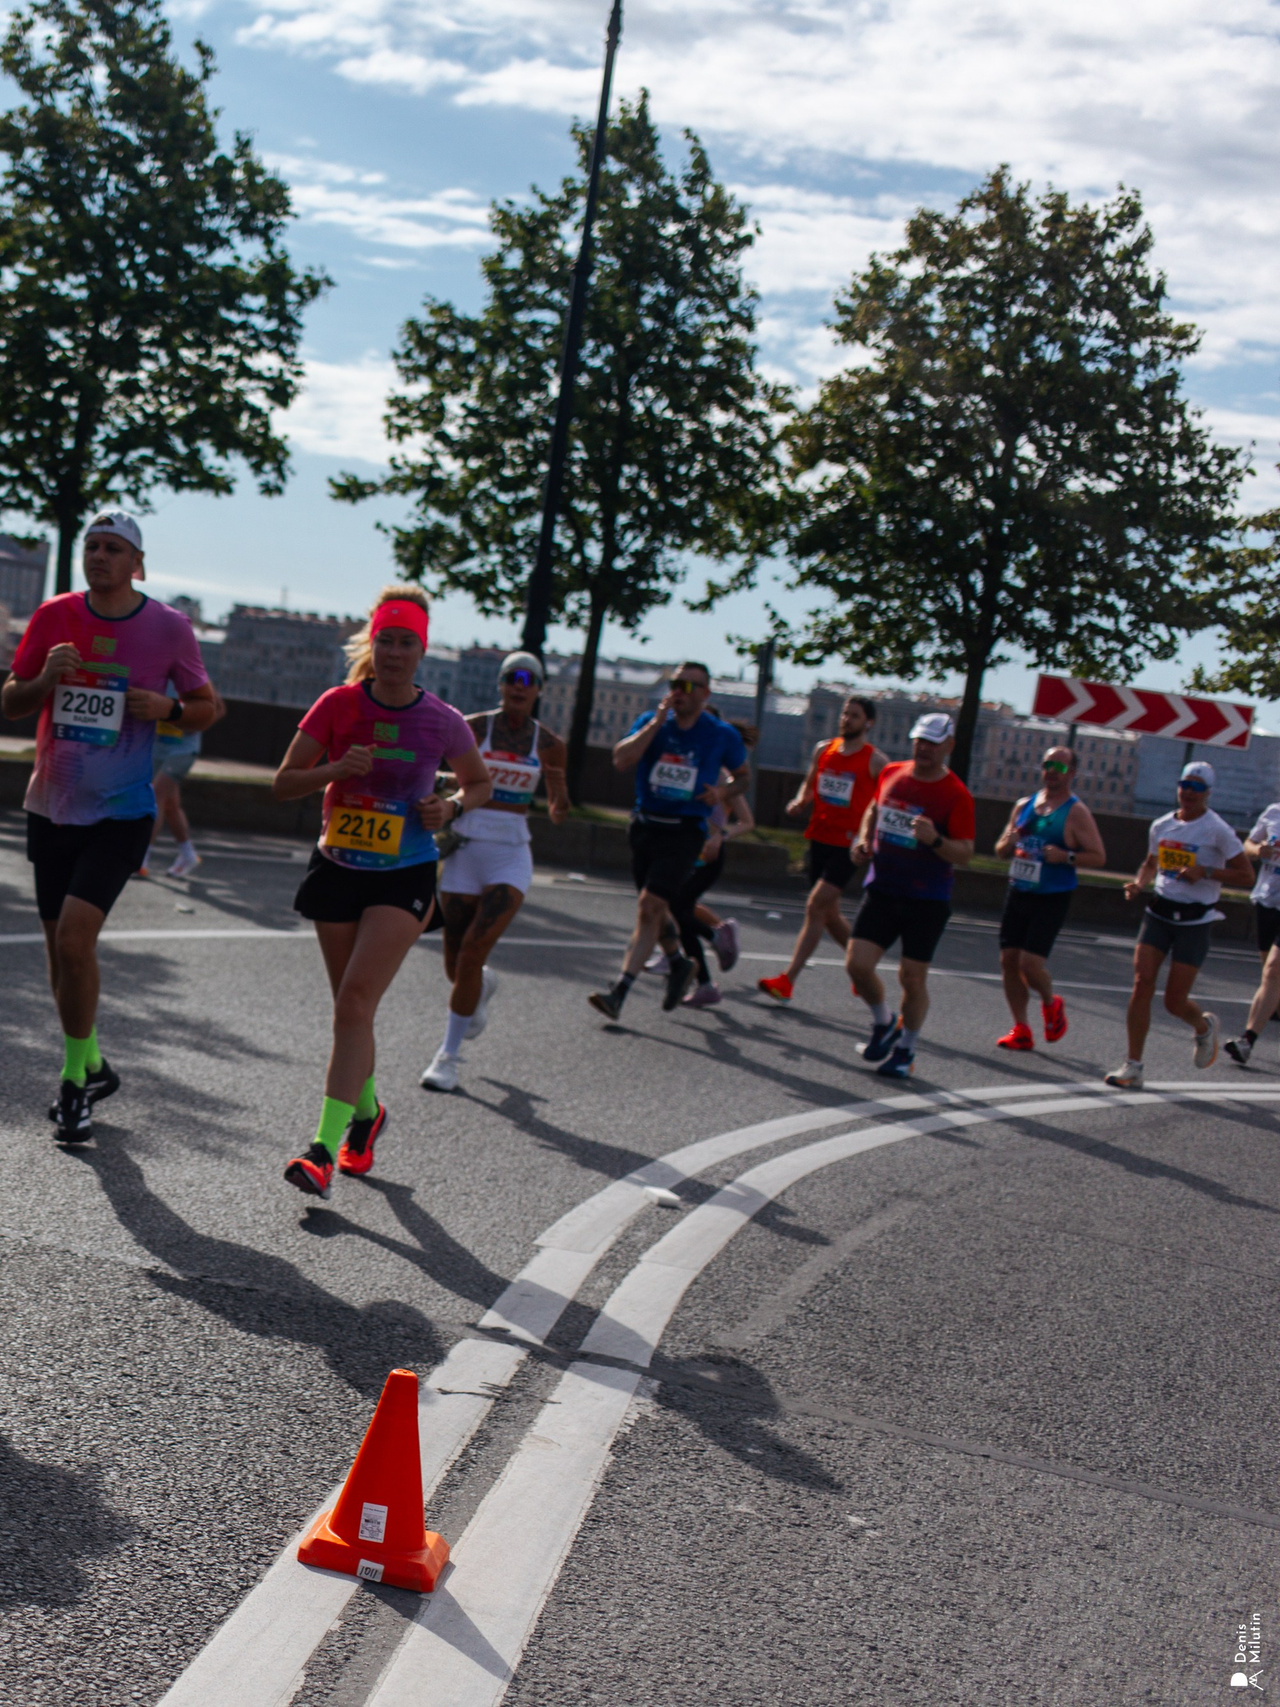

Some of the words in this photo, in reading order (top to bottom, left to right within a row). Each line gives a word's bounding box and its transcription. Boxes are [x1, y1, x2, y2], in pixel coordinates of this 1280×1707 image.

[61, 691, 114, 717] 2208
[73, 715, 98, 723] ВАДИМ
[489, 767, 531, 788] 7272
[337, 814, 390, 841] 2216
[359, 1566, 378, 1579] 1011
